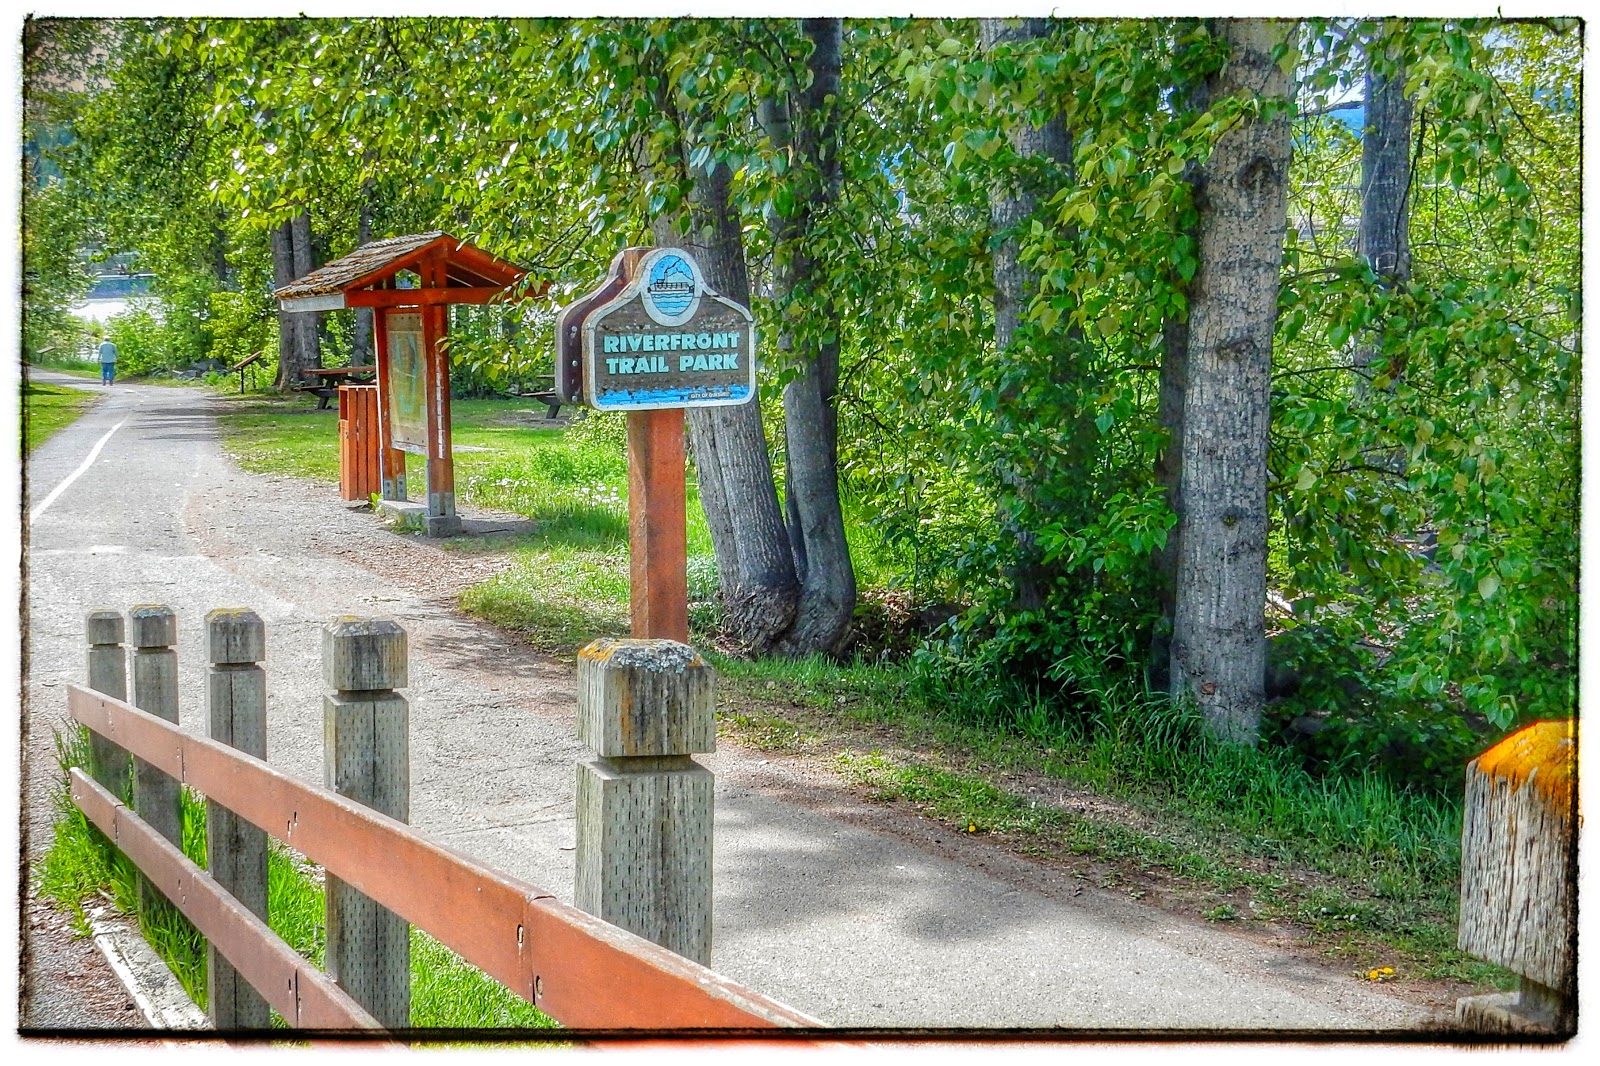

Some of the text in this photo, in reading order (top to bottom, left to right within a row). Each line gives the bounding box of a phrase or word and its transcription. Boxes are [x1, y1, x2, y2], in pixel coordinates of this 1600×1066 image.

[604, 332, 740, 353] RIVERFRONT
[606, 353, 739, 375] TRAIL PARK
